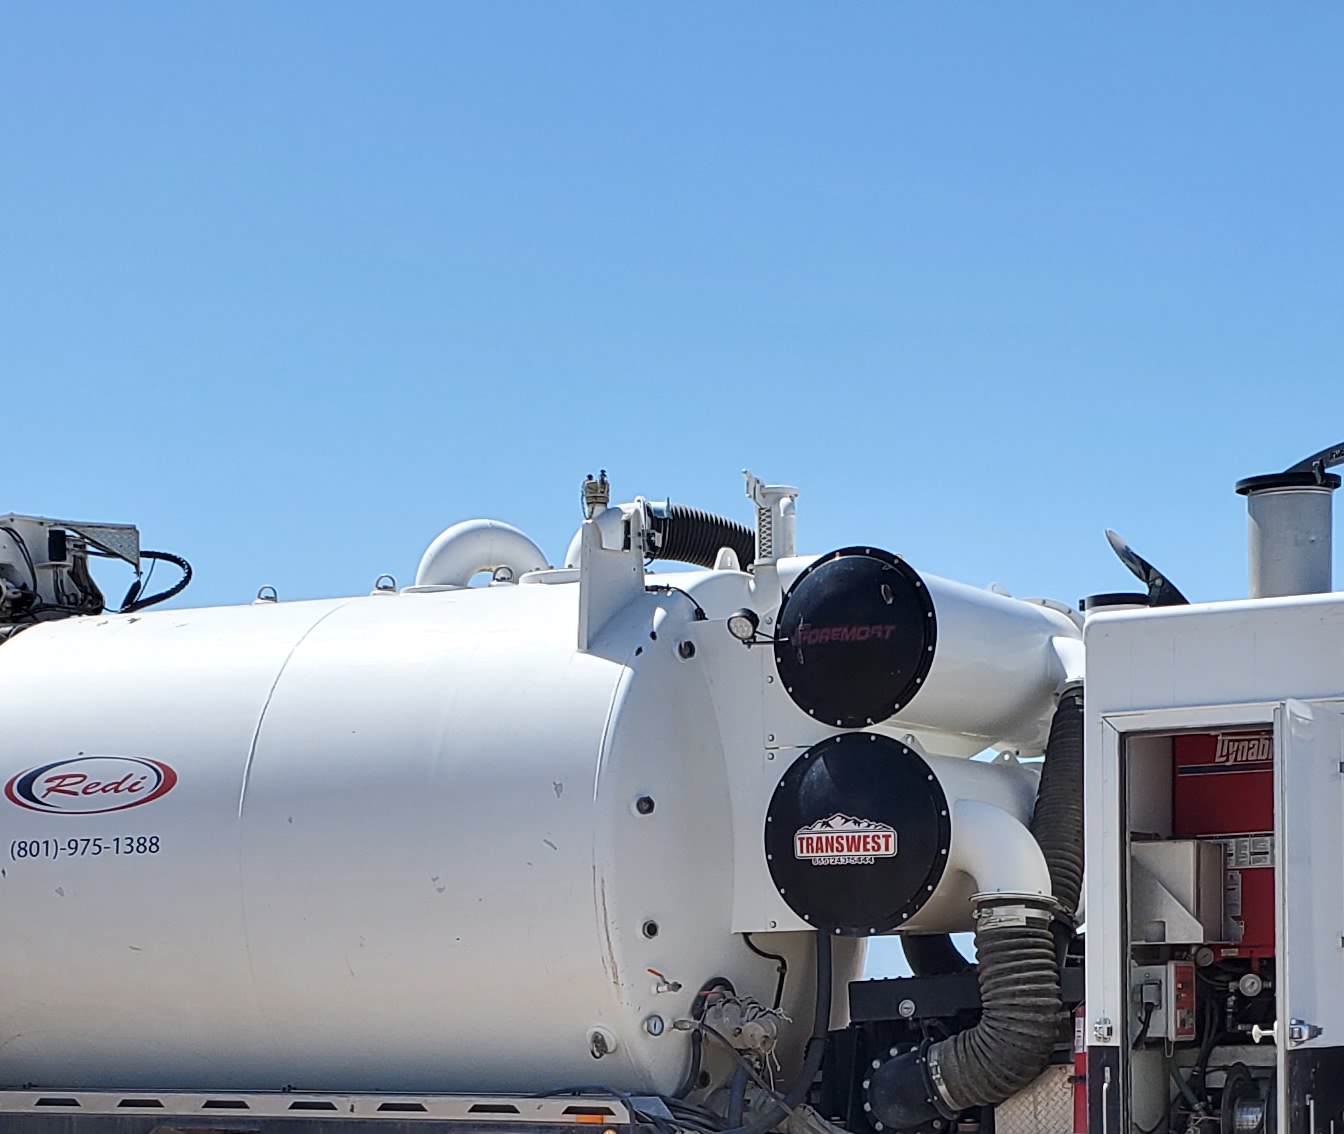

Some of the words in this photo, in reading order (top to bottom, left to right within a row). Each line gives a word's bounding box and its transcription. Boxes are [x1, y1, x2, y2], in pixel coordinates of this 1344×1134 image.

[40, 772, 147, 799] Redi
[10, 836, 160, 861] (801)-975-1388
[797, 834, 892, 855] TRANSWEST
